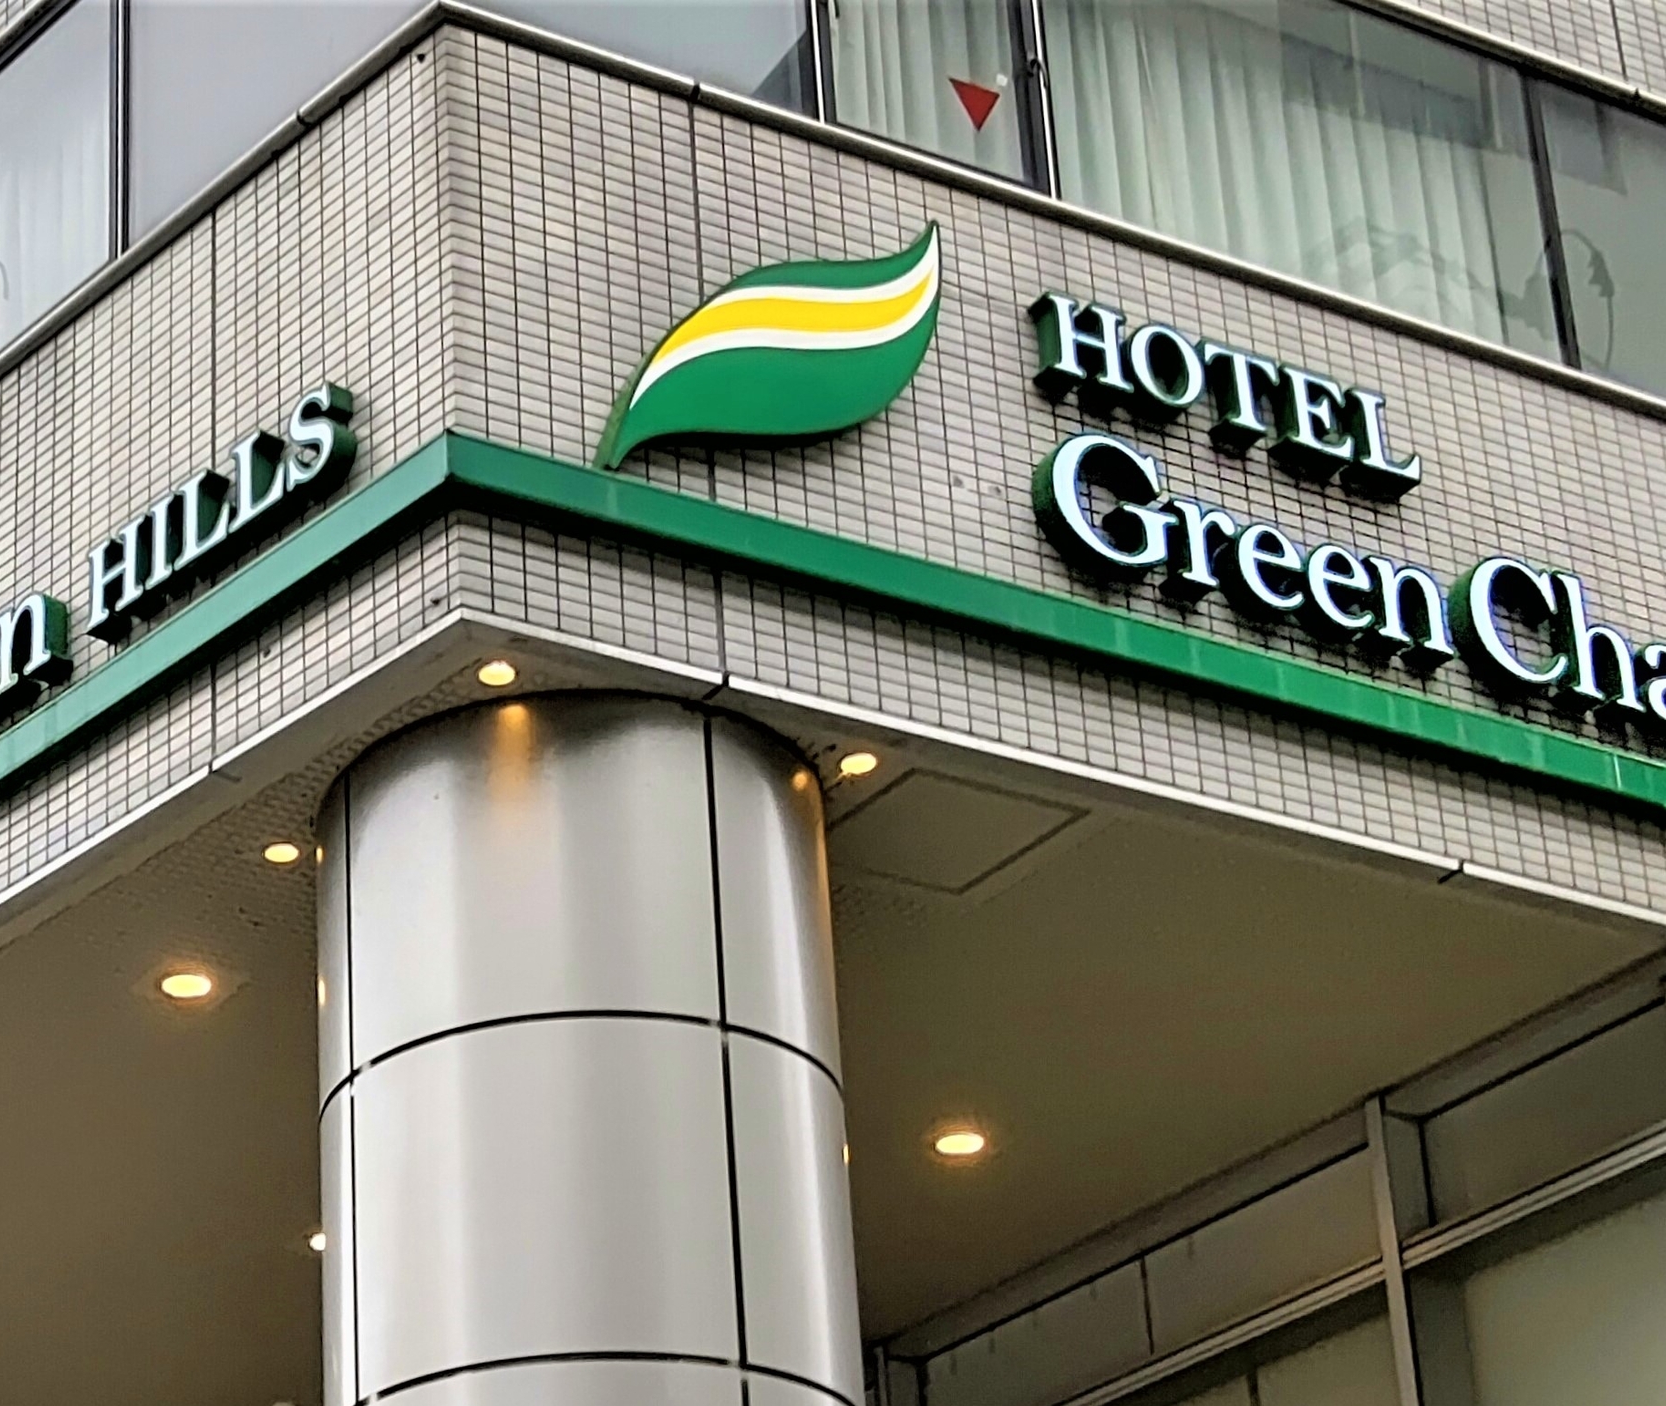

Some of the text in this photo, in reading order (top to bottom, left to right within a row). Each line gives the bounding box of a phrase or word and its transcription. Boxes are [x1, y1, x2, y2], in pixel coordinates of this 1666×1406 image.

[1039, 292, 1421, 486] HOTEL
[86, 381, 341, 634] HILLS
[1043, 432, 1454, 657] Green
